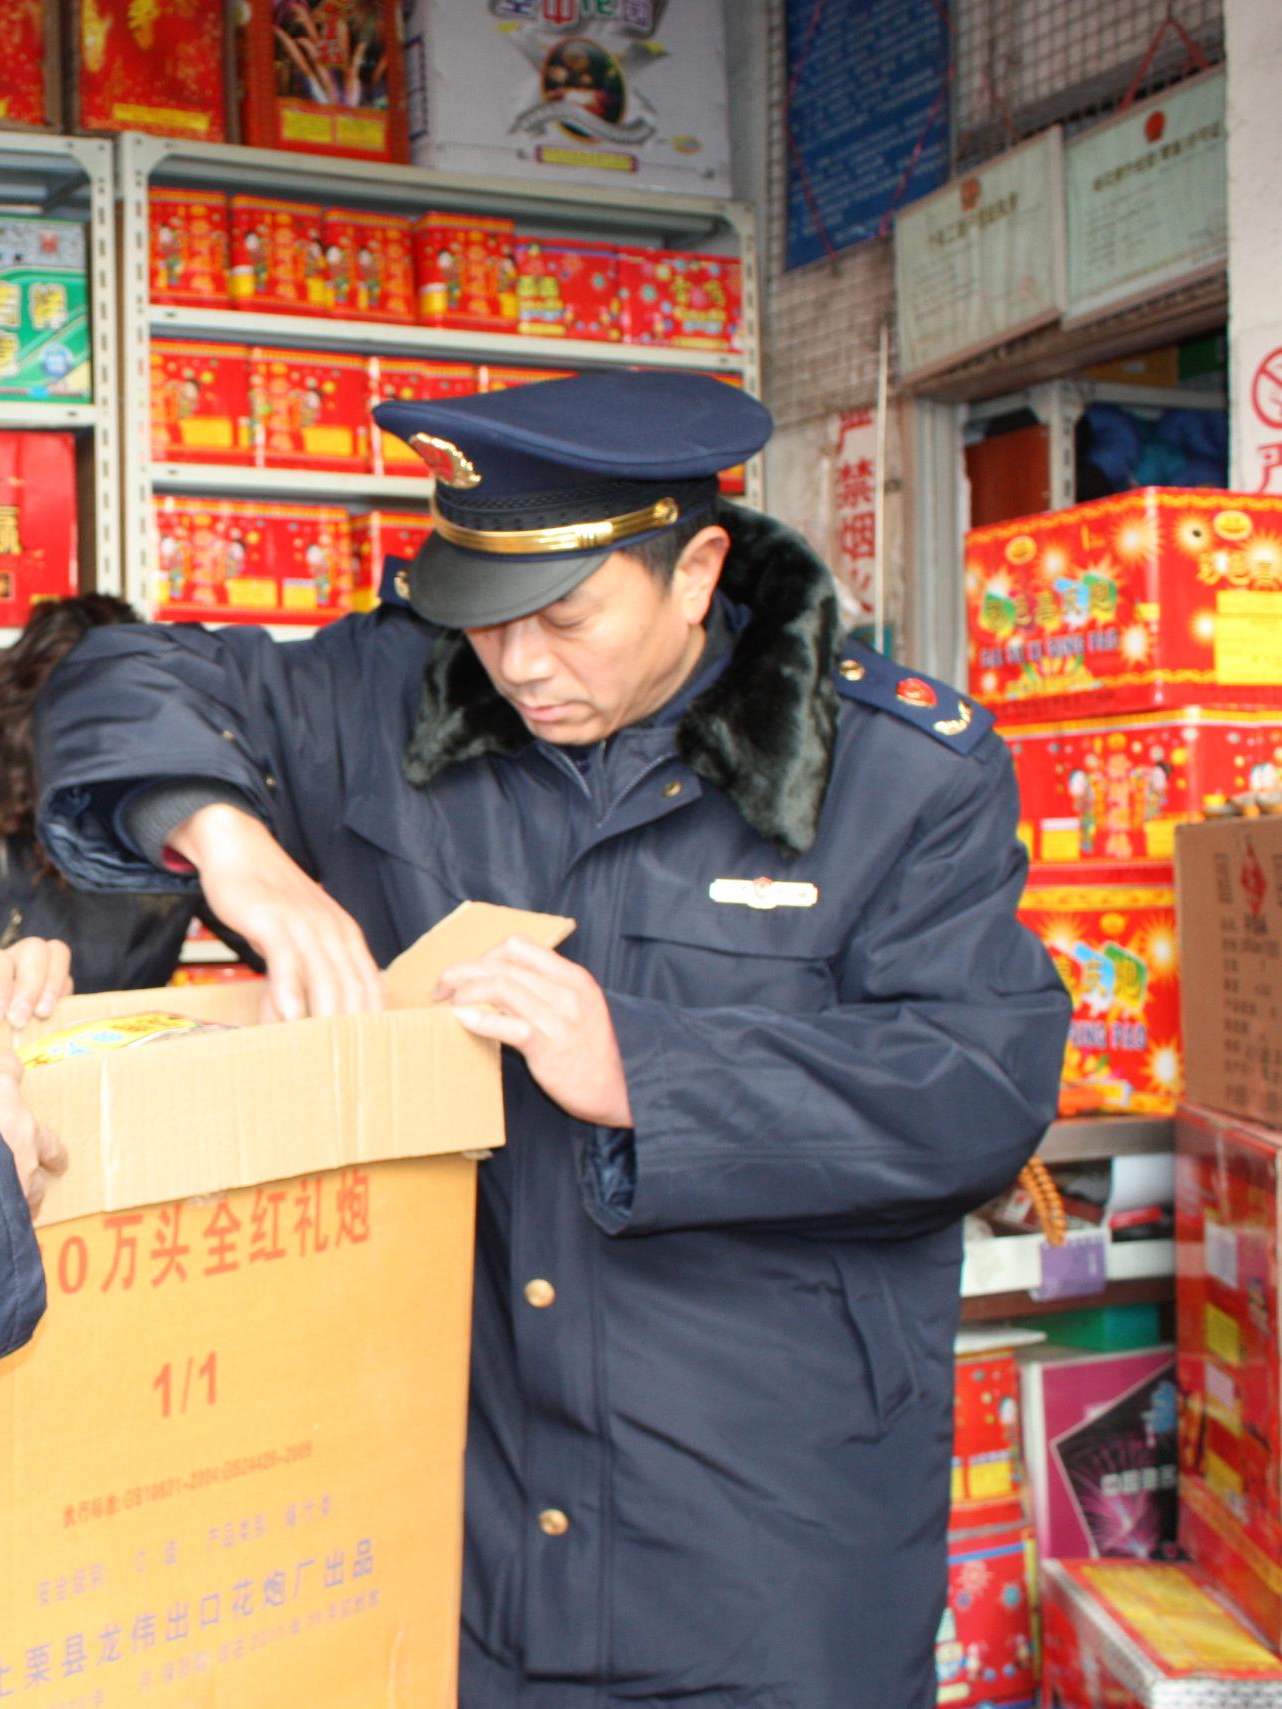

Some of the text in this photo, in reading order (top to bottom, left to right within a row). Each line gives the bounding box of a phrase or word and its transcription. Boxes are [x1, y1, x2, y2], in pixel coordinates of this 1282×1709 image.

[39, 1168, 369, 1295] 0万头全红礼炮
[153, 1351, 217, 1418] 1/1
